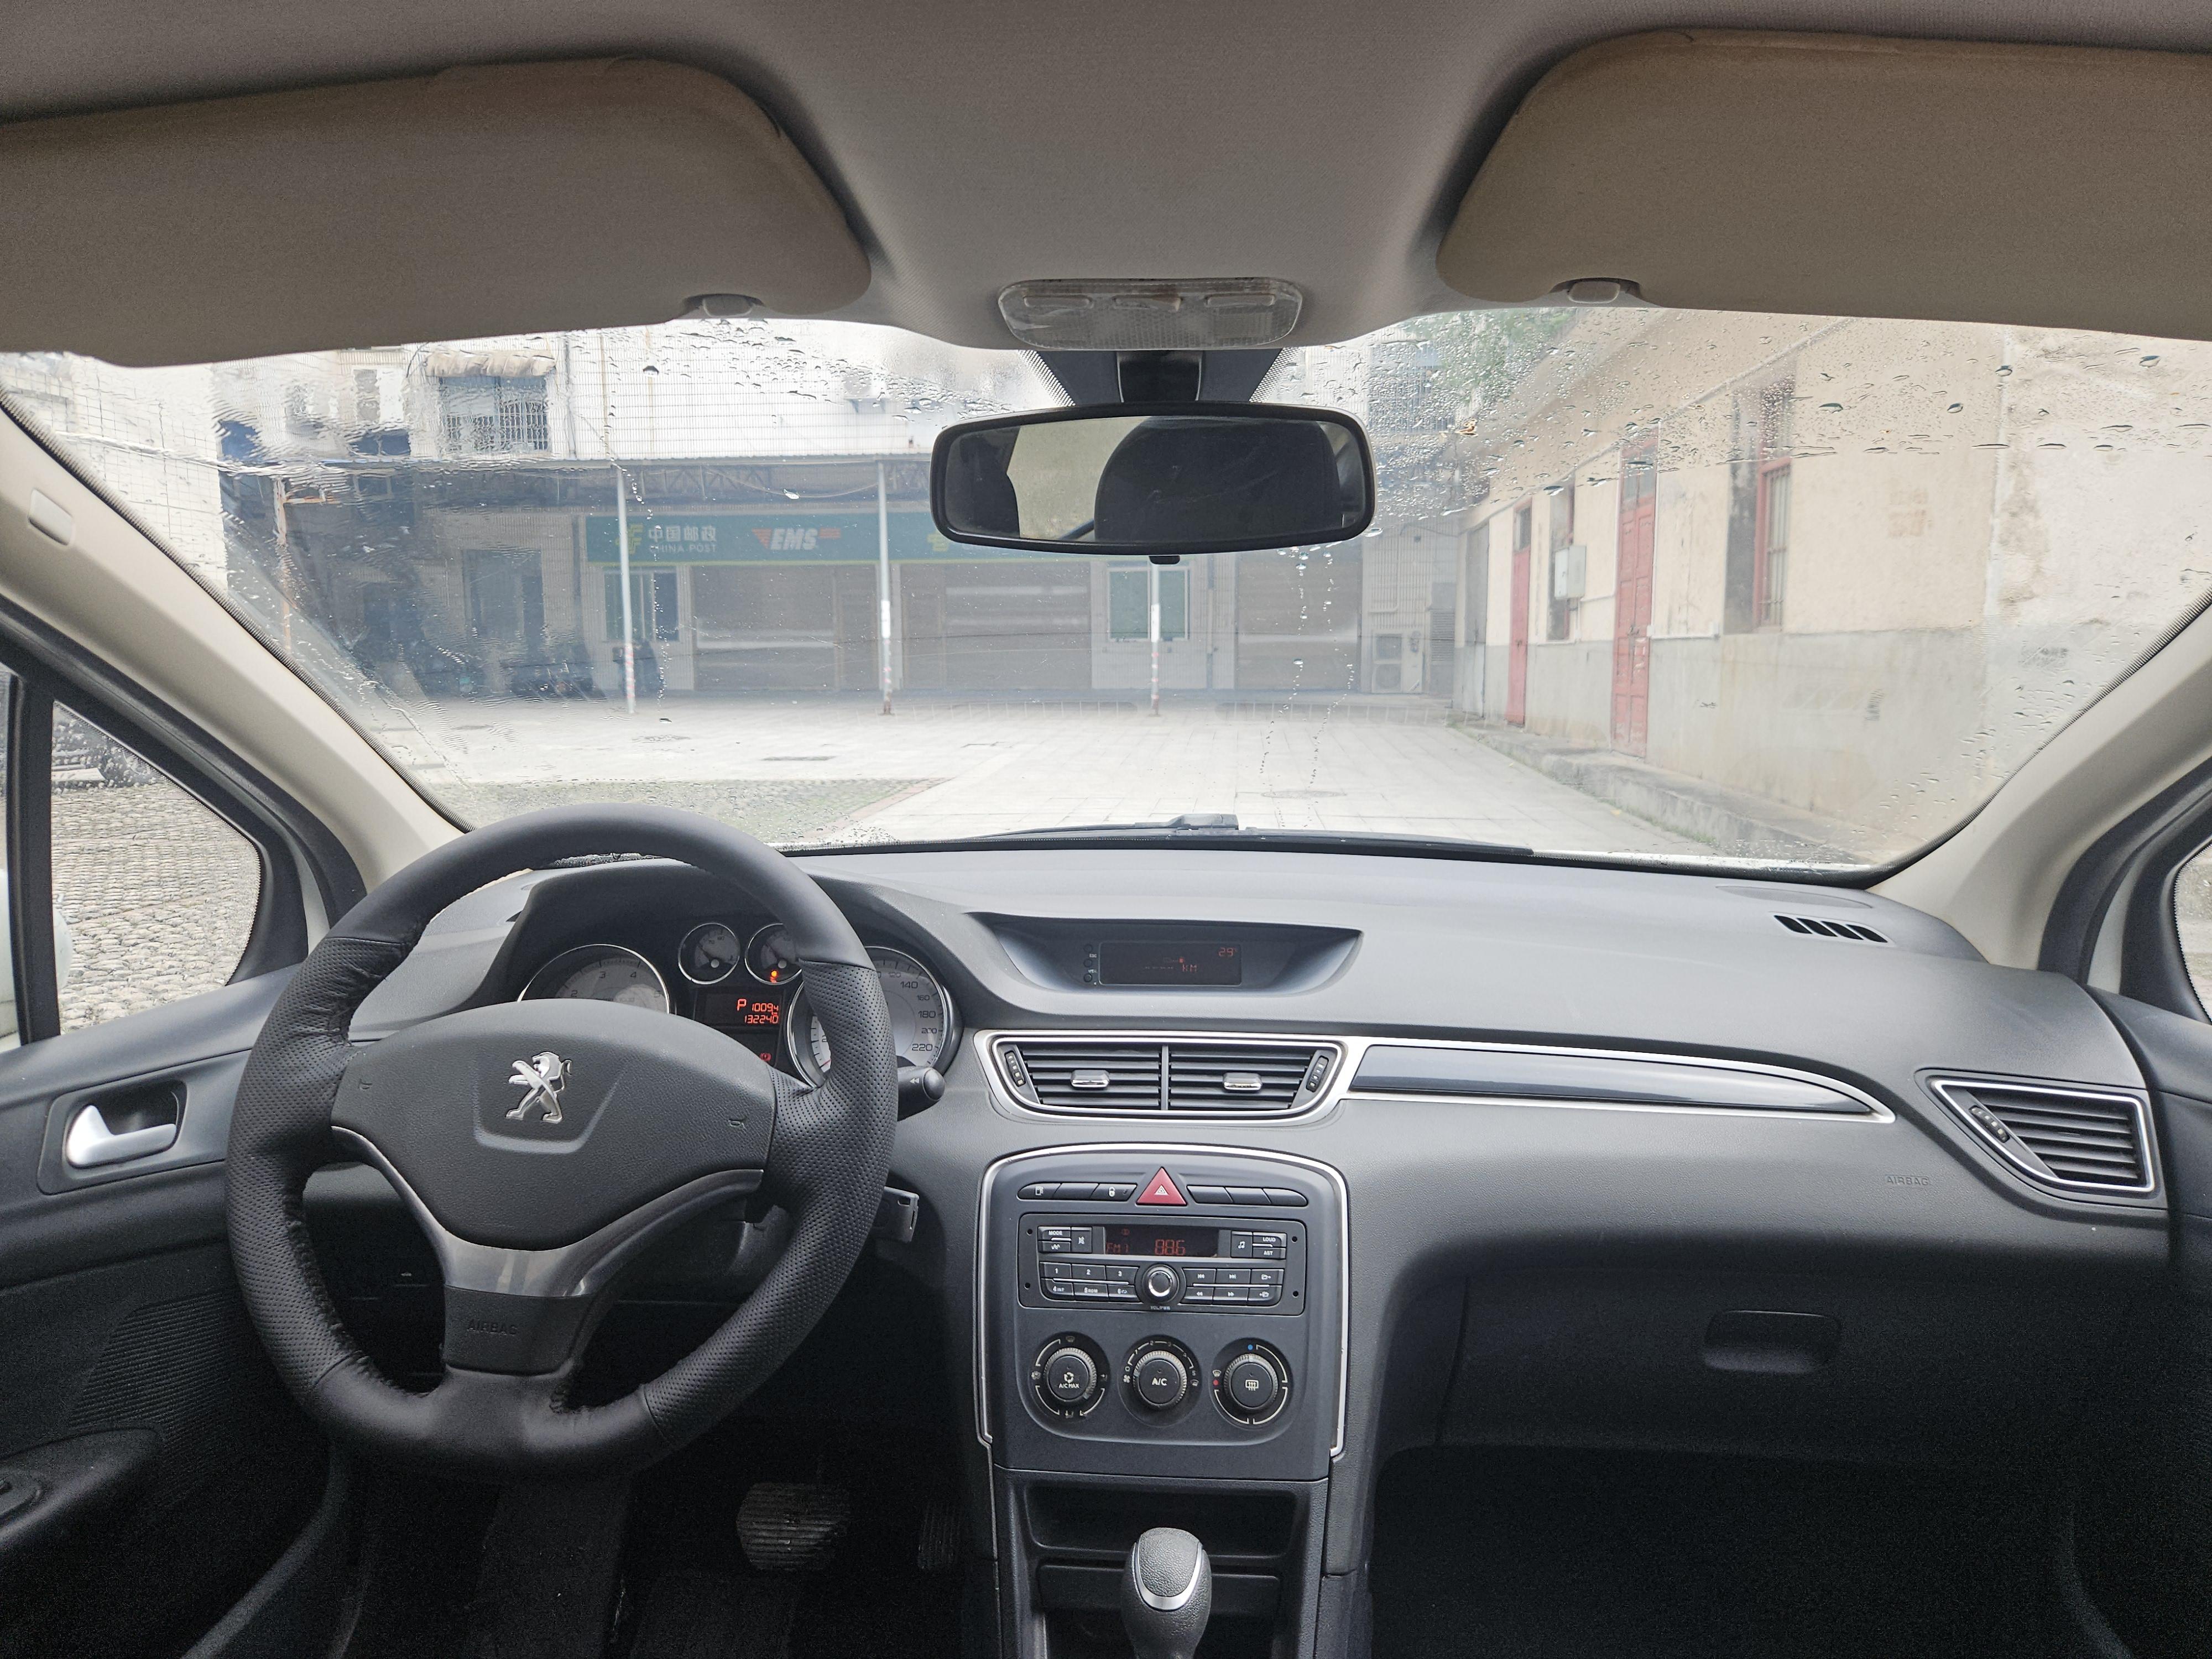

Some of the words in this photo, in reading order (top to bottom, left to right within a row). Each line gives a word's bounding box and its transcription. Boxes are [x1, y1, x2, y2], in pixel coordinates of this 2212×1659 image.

[648, 525, 717, 542] 中国邮政
[770, 527, 818, 550] EMS
[689, 544, 717, 552] POST
[737, 998, 747, 1011] P
[744, 1014, 779, 1024] 132240
[1886, 1176, 1929, 1186] AIRBAG
[1151, 1378, 1167, 1386] A/C
